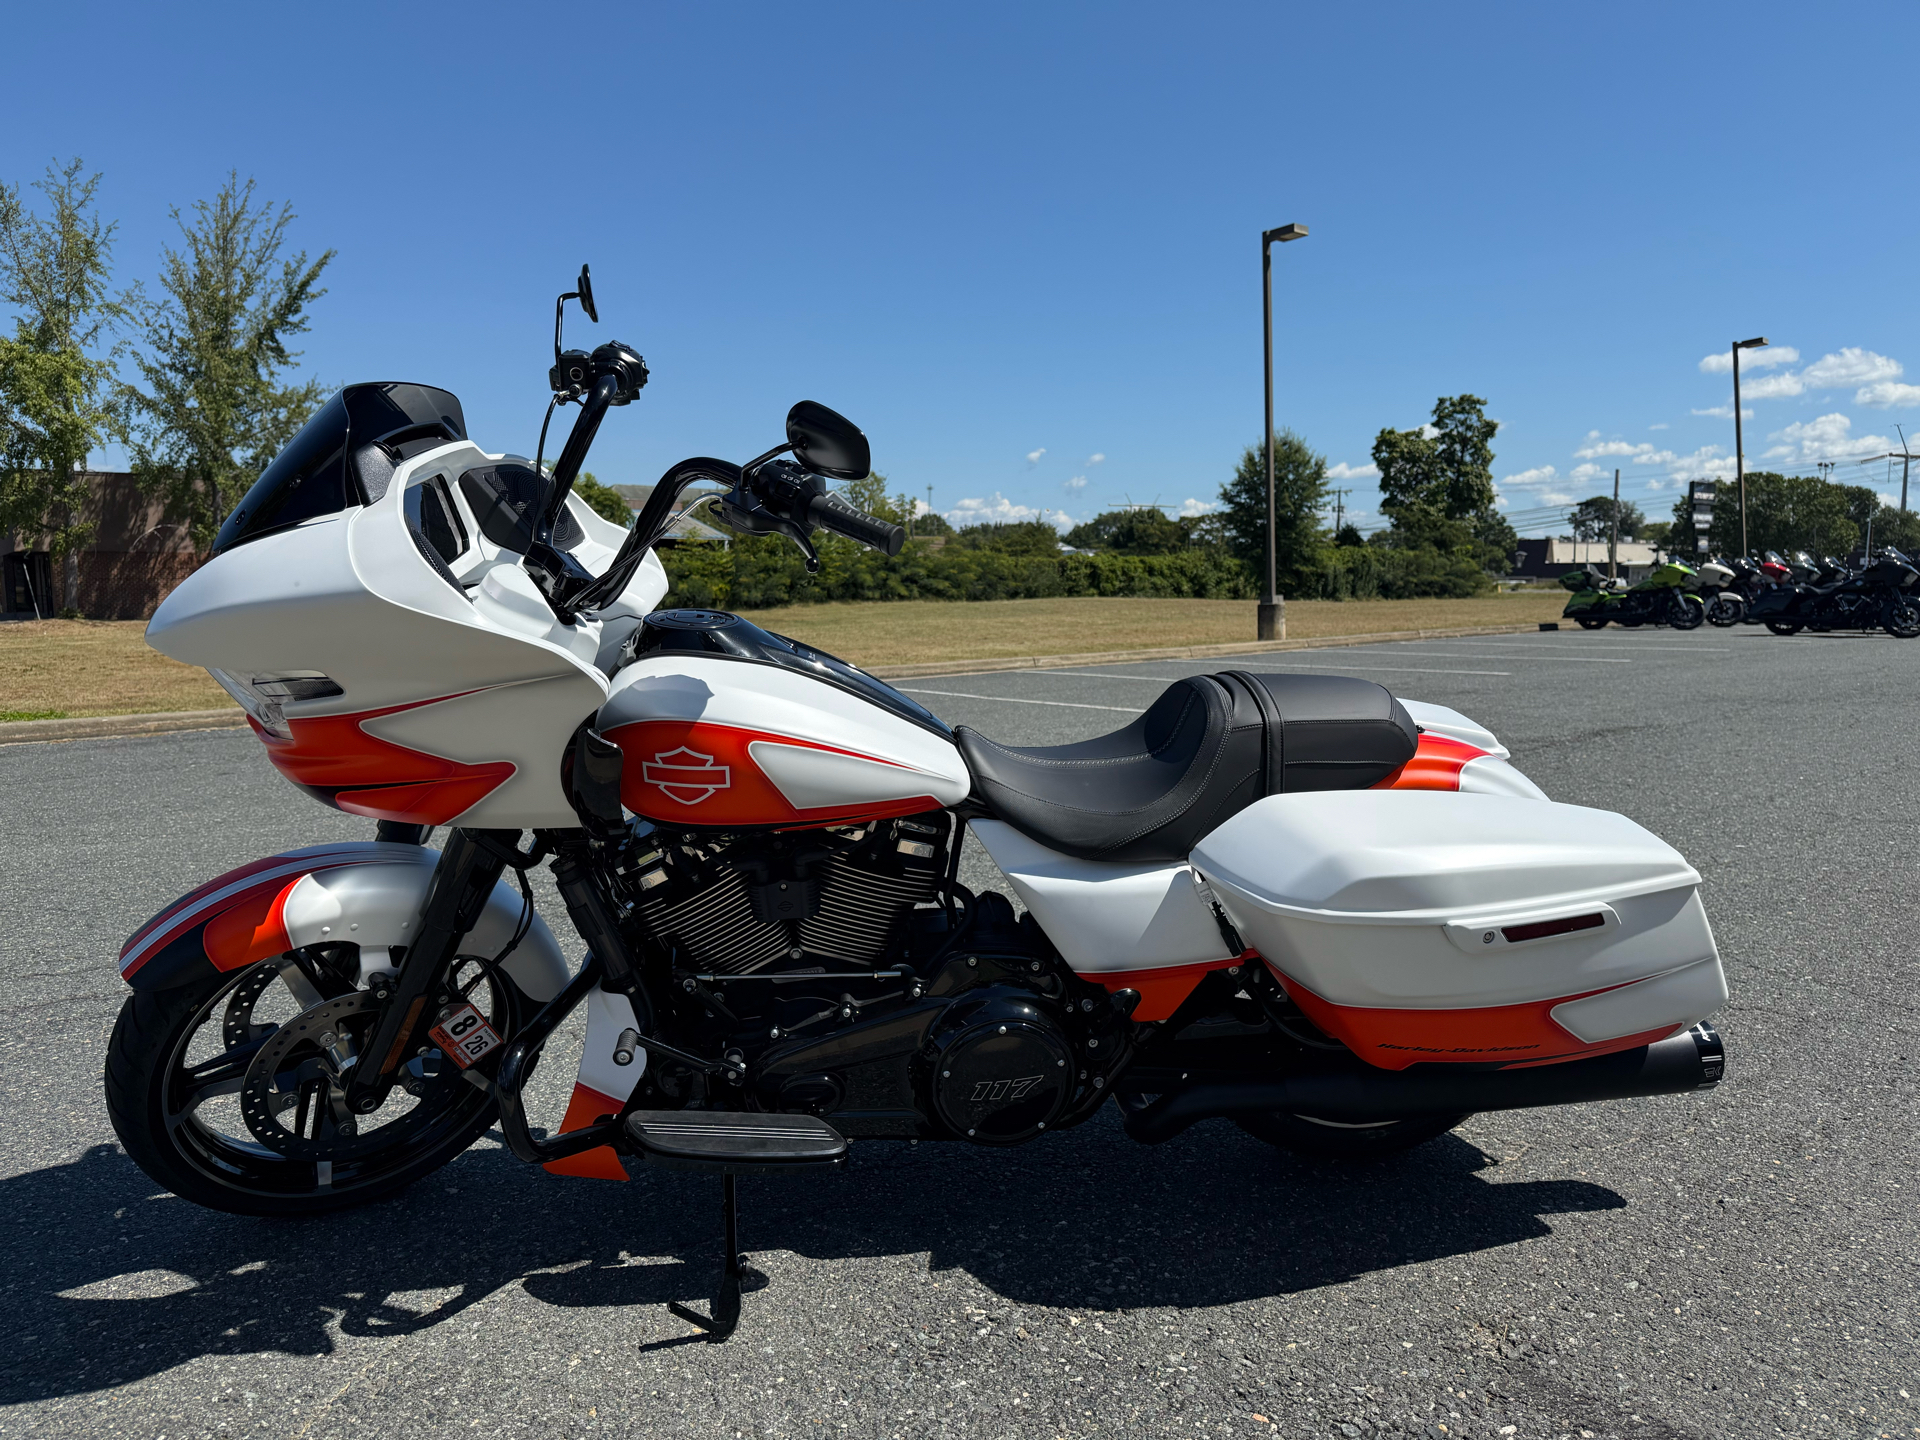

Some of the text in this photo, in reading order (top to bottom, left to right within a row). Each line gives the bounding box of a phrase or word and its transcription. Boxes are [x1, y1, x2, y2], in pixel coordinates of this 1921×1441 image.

[451, 1015, 478, 1036] 8
[464, 1034, 489, 1055] 26
[1376, 1042, 1541, 1053] Harley-Davidson
[970, 1074, 1045, 1101] 117
